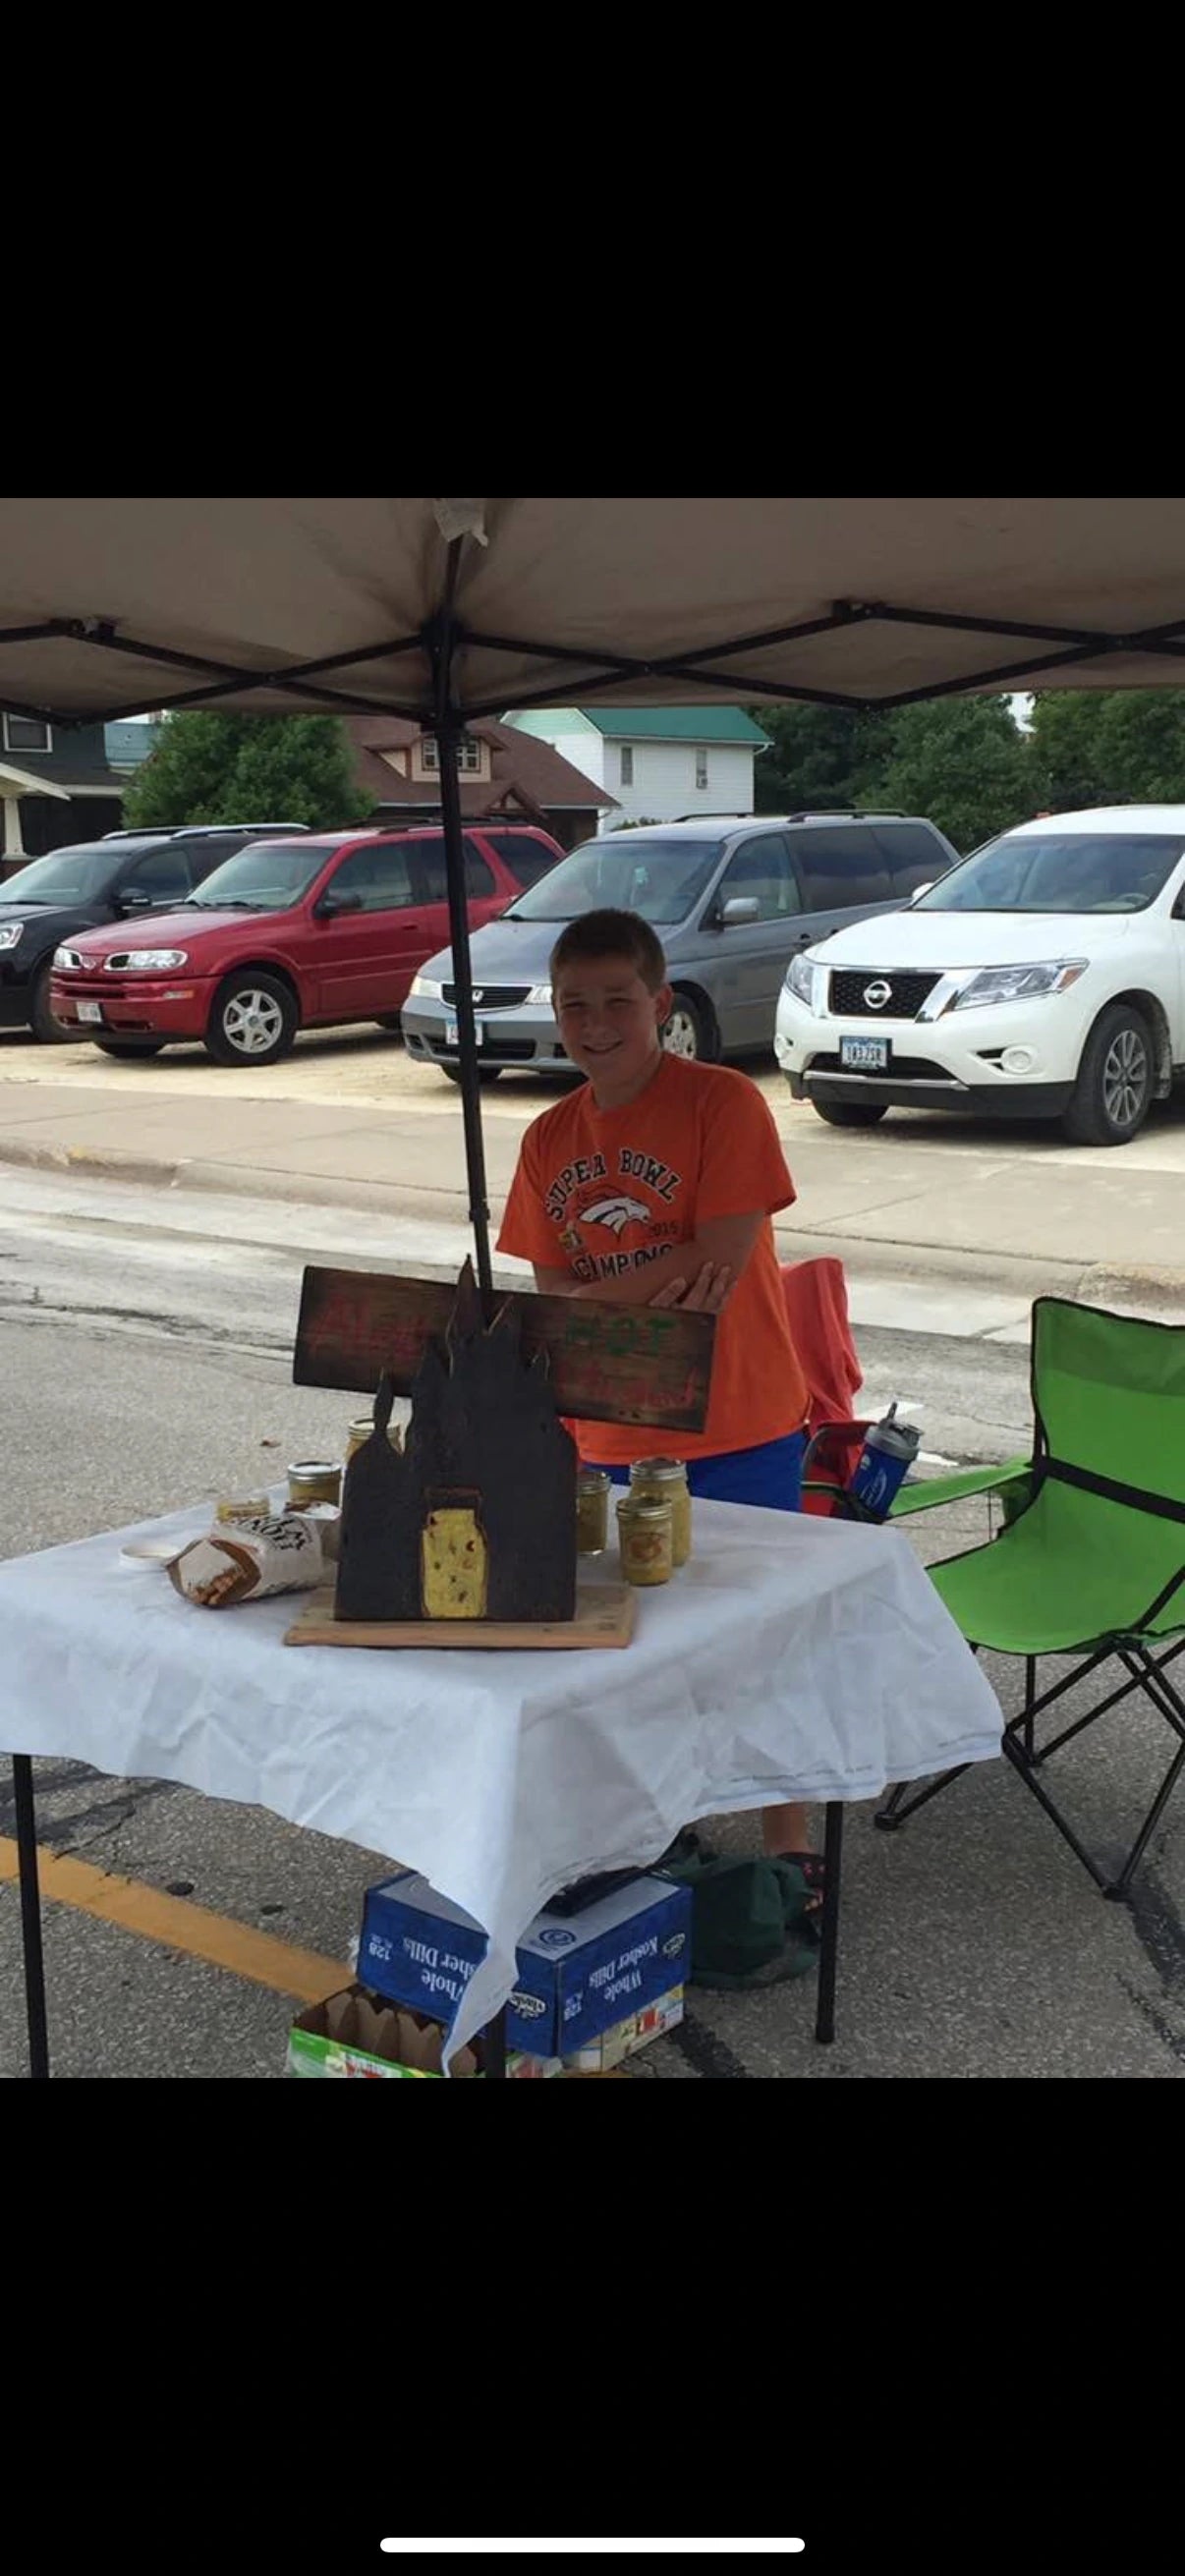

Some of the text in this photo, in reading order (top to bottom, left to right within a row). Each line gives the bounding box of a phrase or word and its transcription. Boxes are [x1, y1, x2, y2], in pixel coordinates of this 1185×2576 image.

[619, 1148, 682, 1204] BOWL
[368, 1942, 390, 1961] 128
[403, 1936, 438, 1969] Dills
[603, 1969, 642, 2003] Whole
